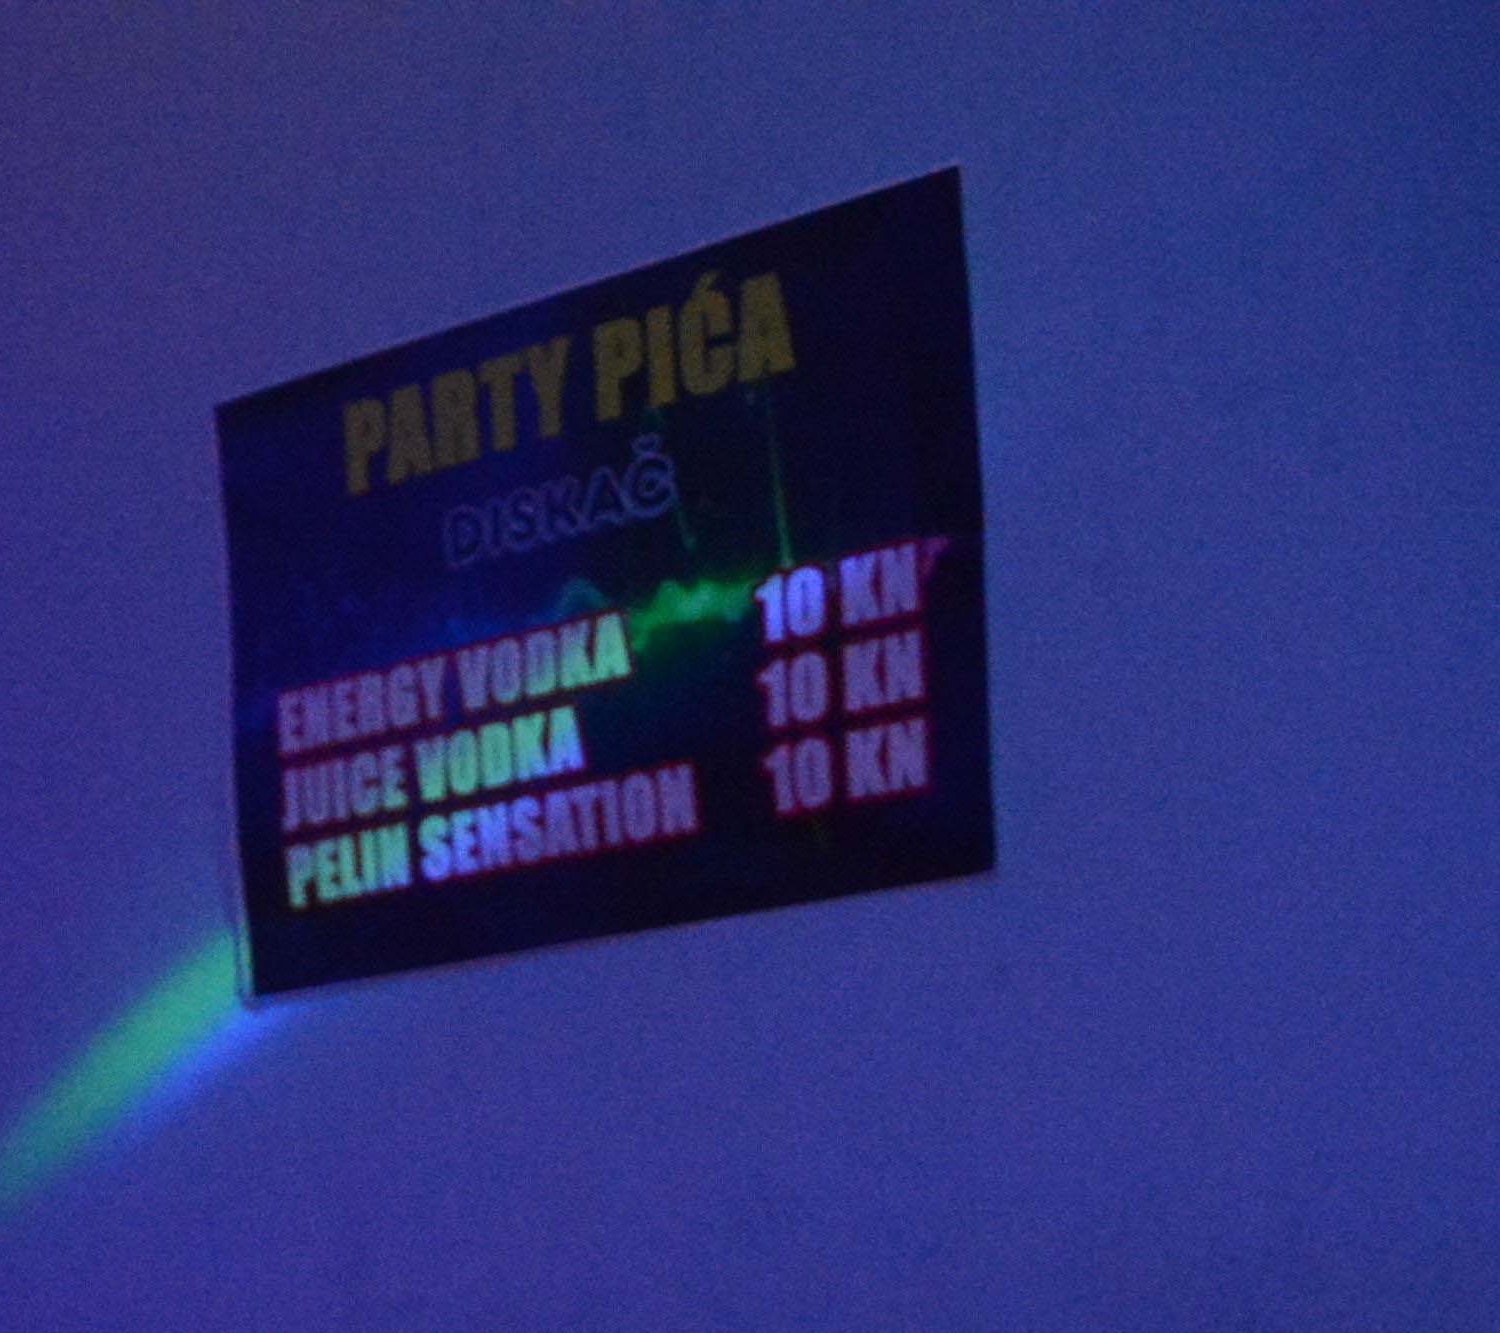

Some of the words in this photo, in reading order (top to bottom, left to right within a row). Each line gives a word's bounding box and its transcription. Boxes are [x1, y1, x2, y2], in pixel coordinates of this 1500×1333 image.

[346, 338, 569, 494] PARTY
[592, 274, 796, 420] PIĆA
[446, 437, 676, 566] DISKAČ
[757, 569, 825, 641] 10
[841, 545, 917, 623] KN
[280, 659, 447, 753] ENERGY
[457, 615, 631, 710] VODKA
[759, 654, 827, 725] 10
[845, 632, 922, 710] KN
[284, 748, 407, 832] JUICE
[415, 708, 583, 801] VODKA
[766, 741, 832, 810] 10
[849, 720, 925, 795] KN
[289, 825, 411, 909] PELIN
[420, 766, 698, 883] SENSATION
